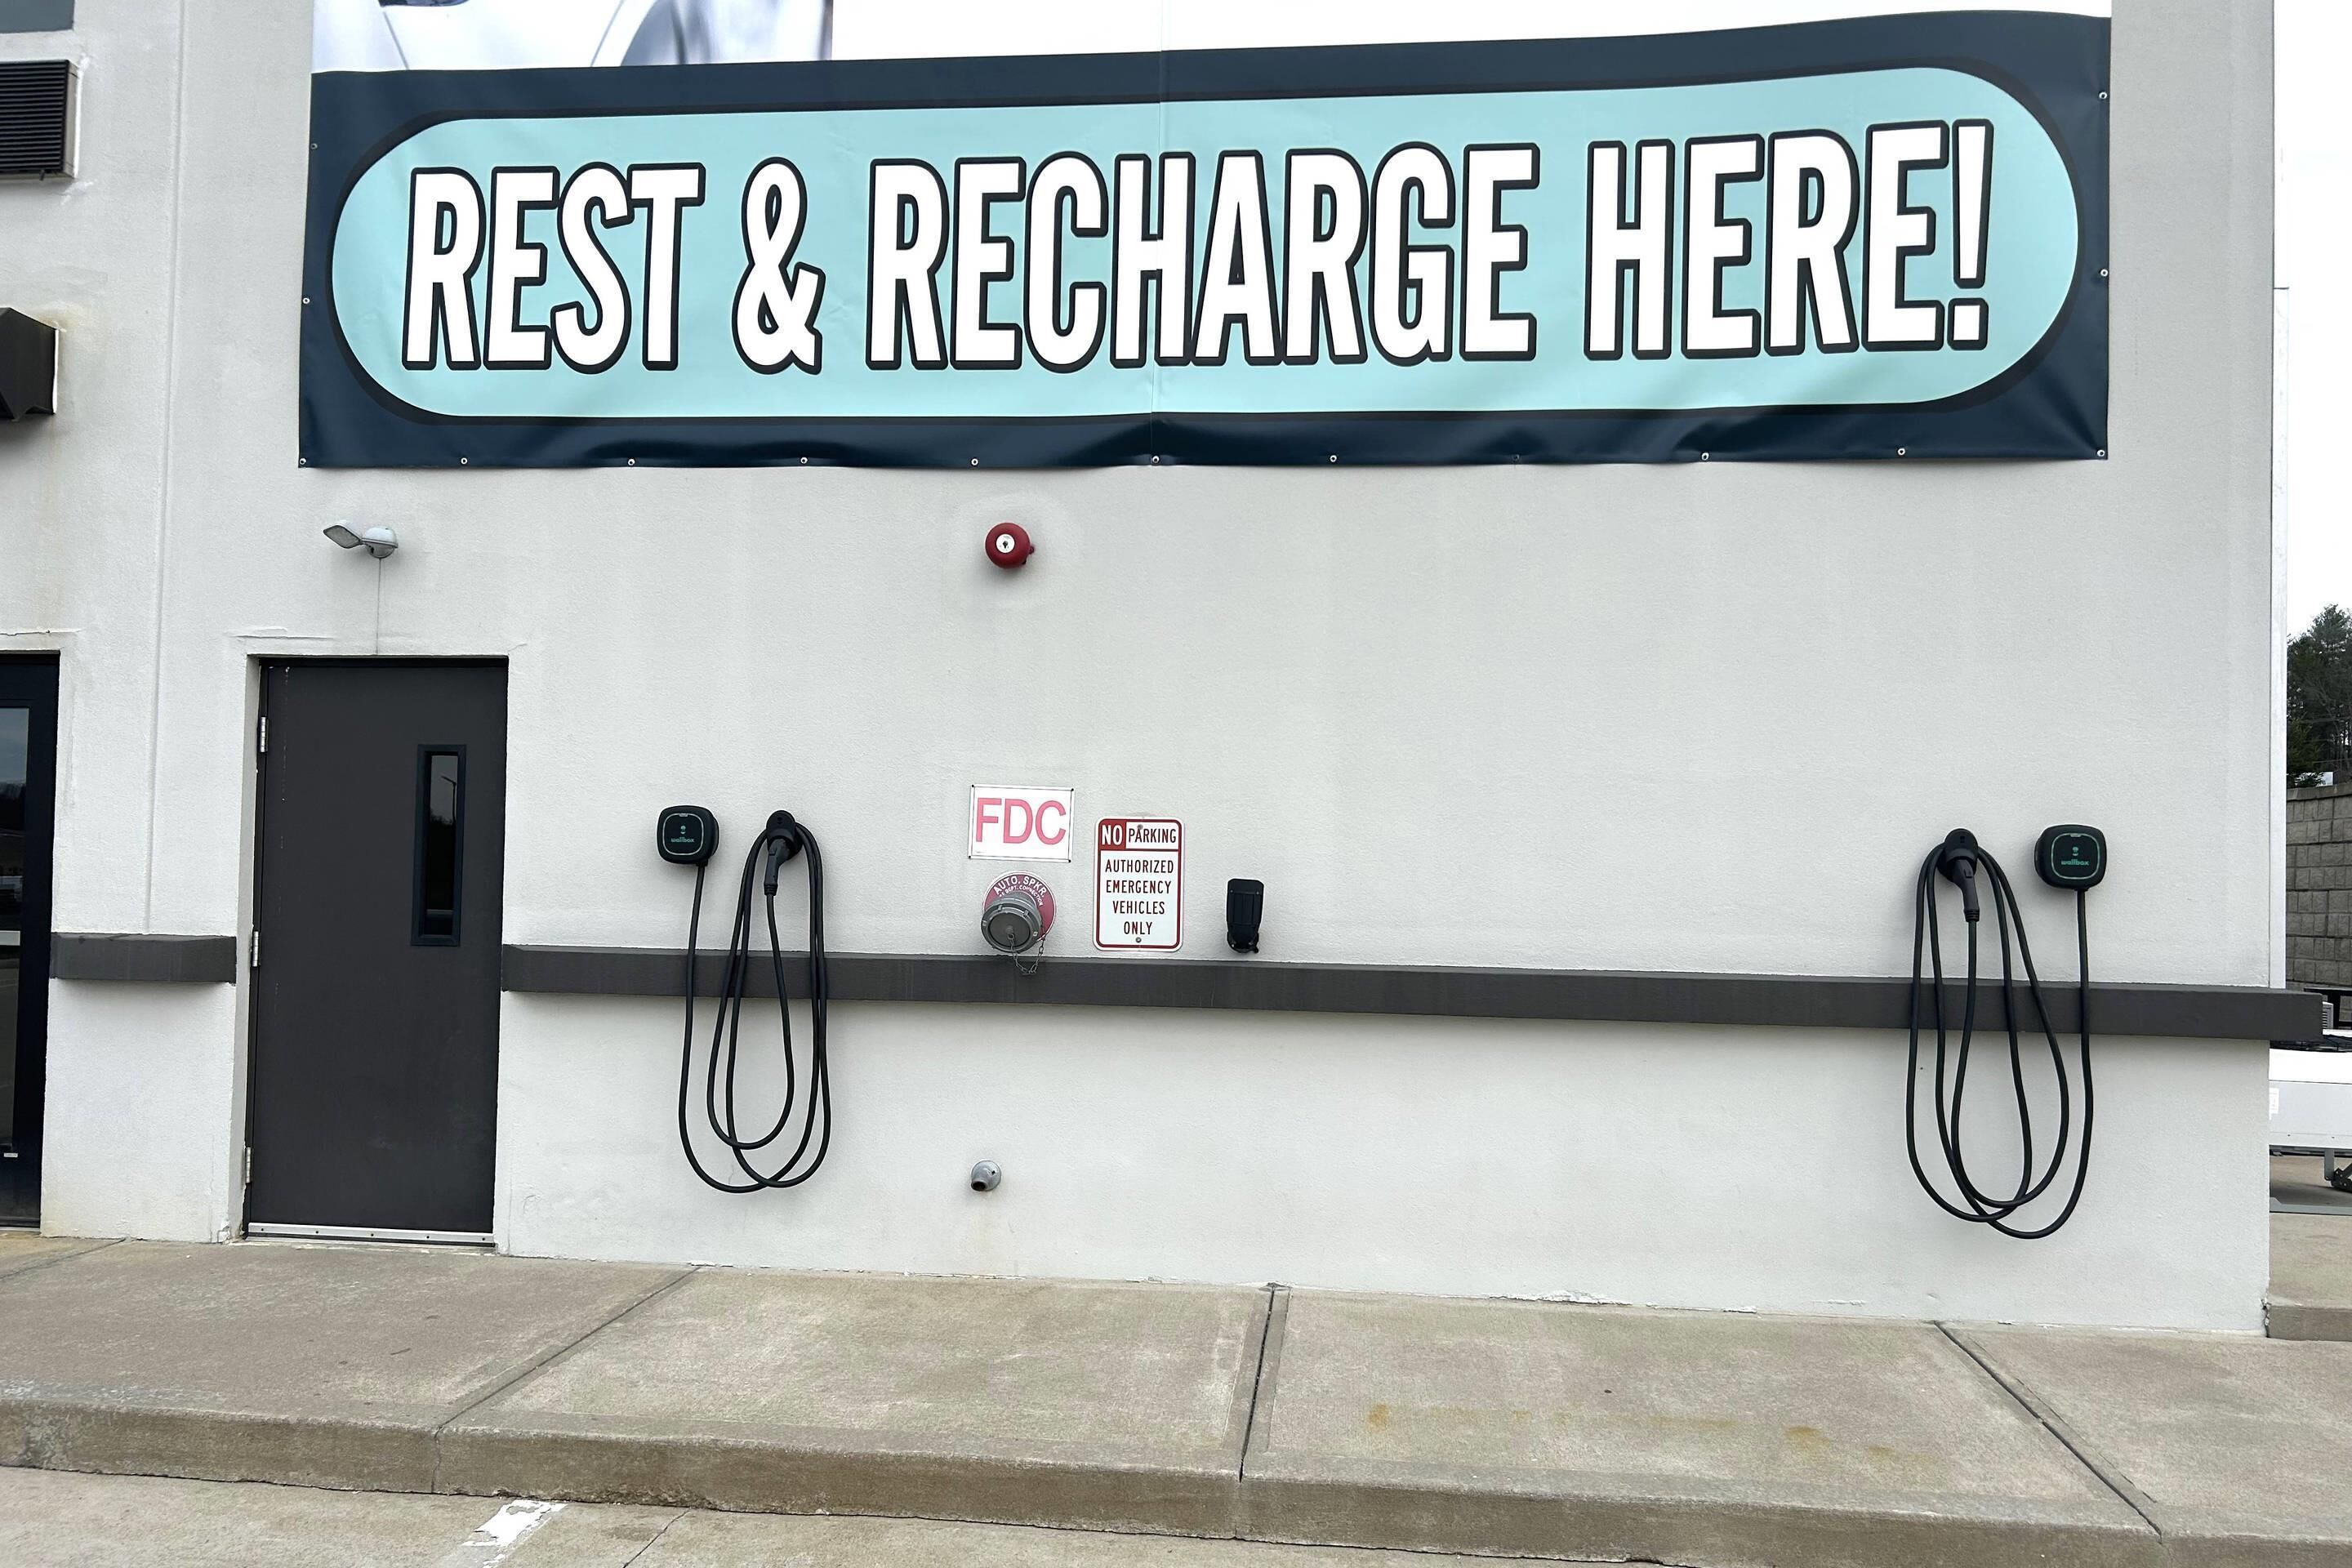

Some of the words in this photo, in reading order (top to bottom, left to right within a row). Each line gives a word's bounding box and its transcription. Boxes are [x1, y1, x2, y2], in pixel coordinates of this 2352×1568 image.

[402, 162, 705, 374] REST
[732, 156, 826, 376] &
[866, 141, 1538, 374] RECHARGE
[1584, 119, 1994, 363] HERE!
[975, 797, 1067, 845] FDC
[1102, 824, 1123, 846] NO
[1128, 828, 1177, 844] PARKING
[1105, 859, 1174, 874] AUTHORIZED
[993, 875, 1021, 895] AUTO.
[1023, 875, 1047, 898] SPKR.
[1106, 880, 1172, 894] EMERGENCY
[1112, 900, 1165, 915] VEHICLES
[1123, 920, 1153, 935] ONLY
